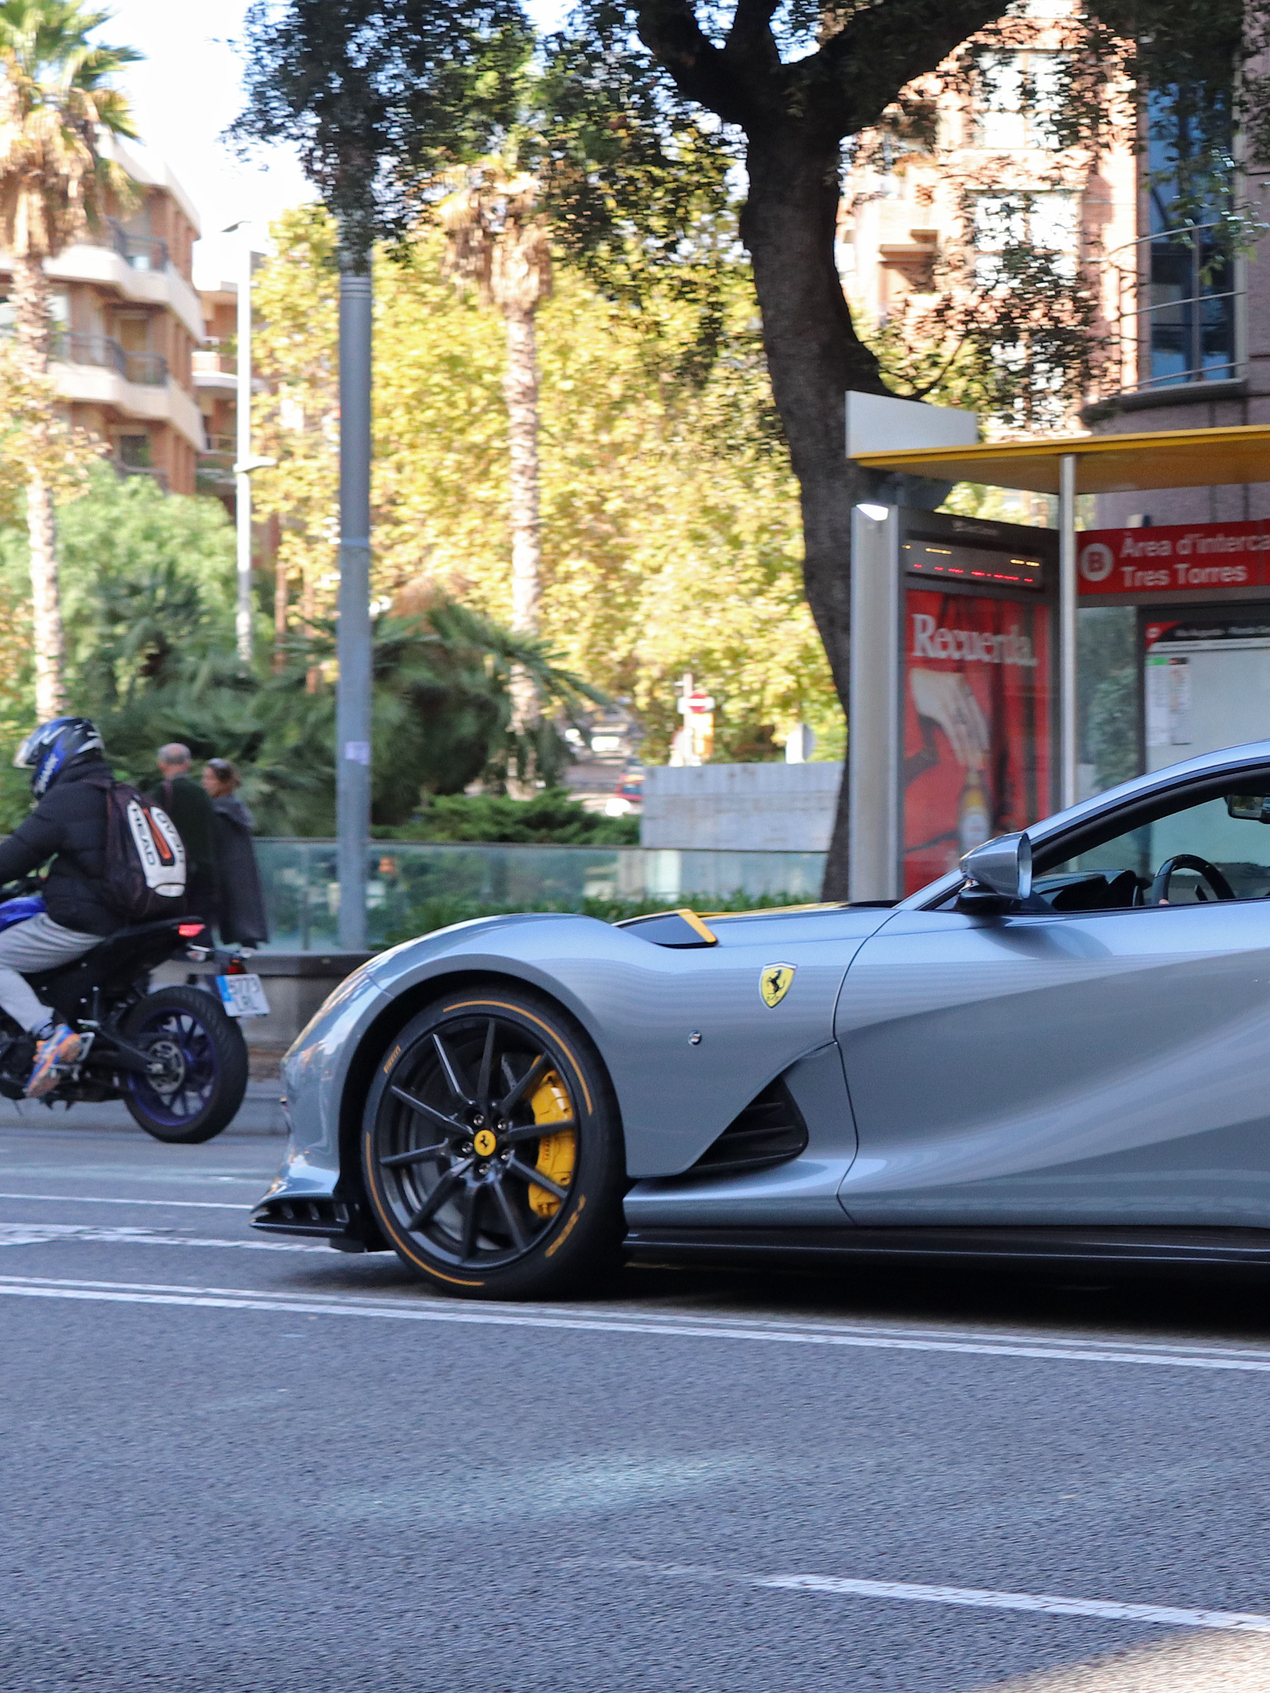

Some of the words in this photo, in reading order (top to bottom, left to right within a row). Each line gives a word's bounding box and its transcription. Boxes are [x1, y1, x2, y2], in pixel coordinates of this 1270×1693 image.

[1119, 532, 1172, 558] Àrea
[1119, 566, 1171, 587] Tres
[1173, 563, 1249, 584] Torres
[131, 807, 156, 866] HEAD
